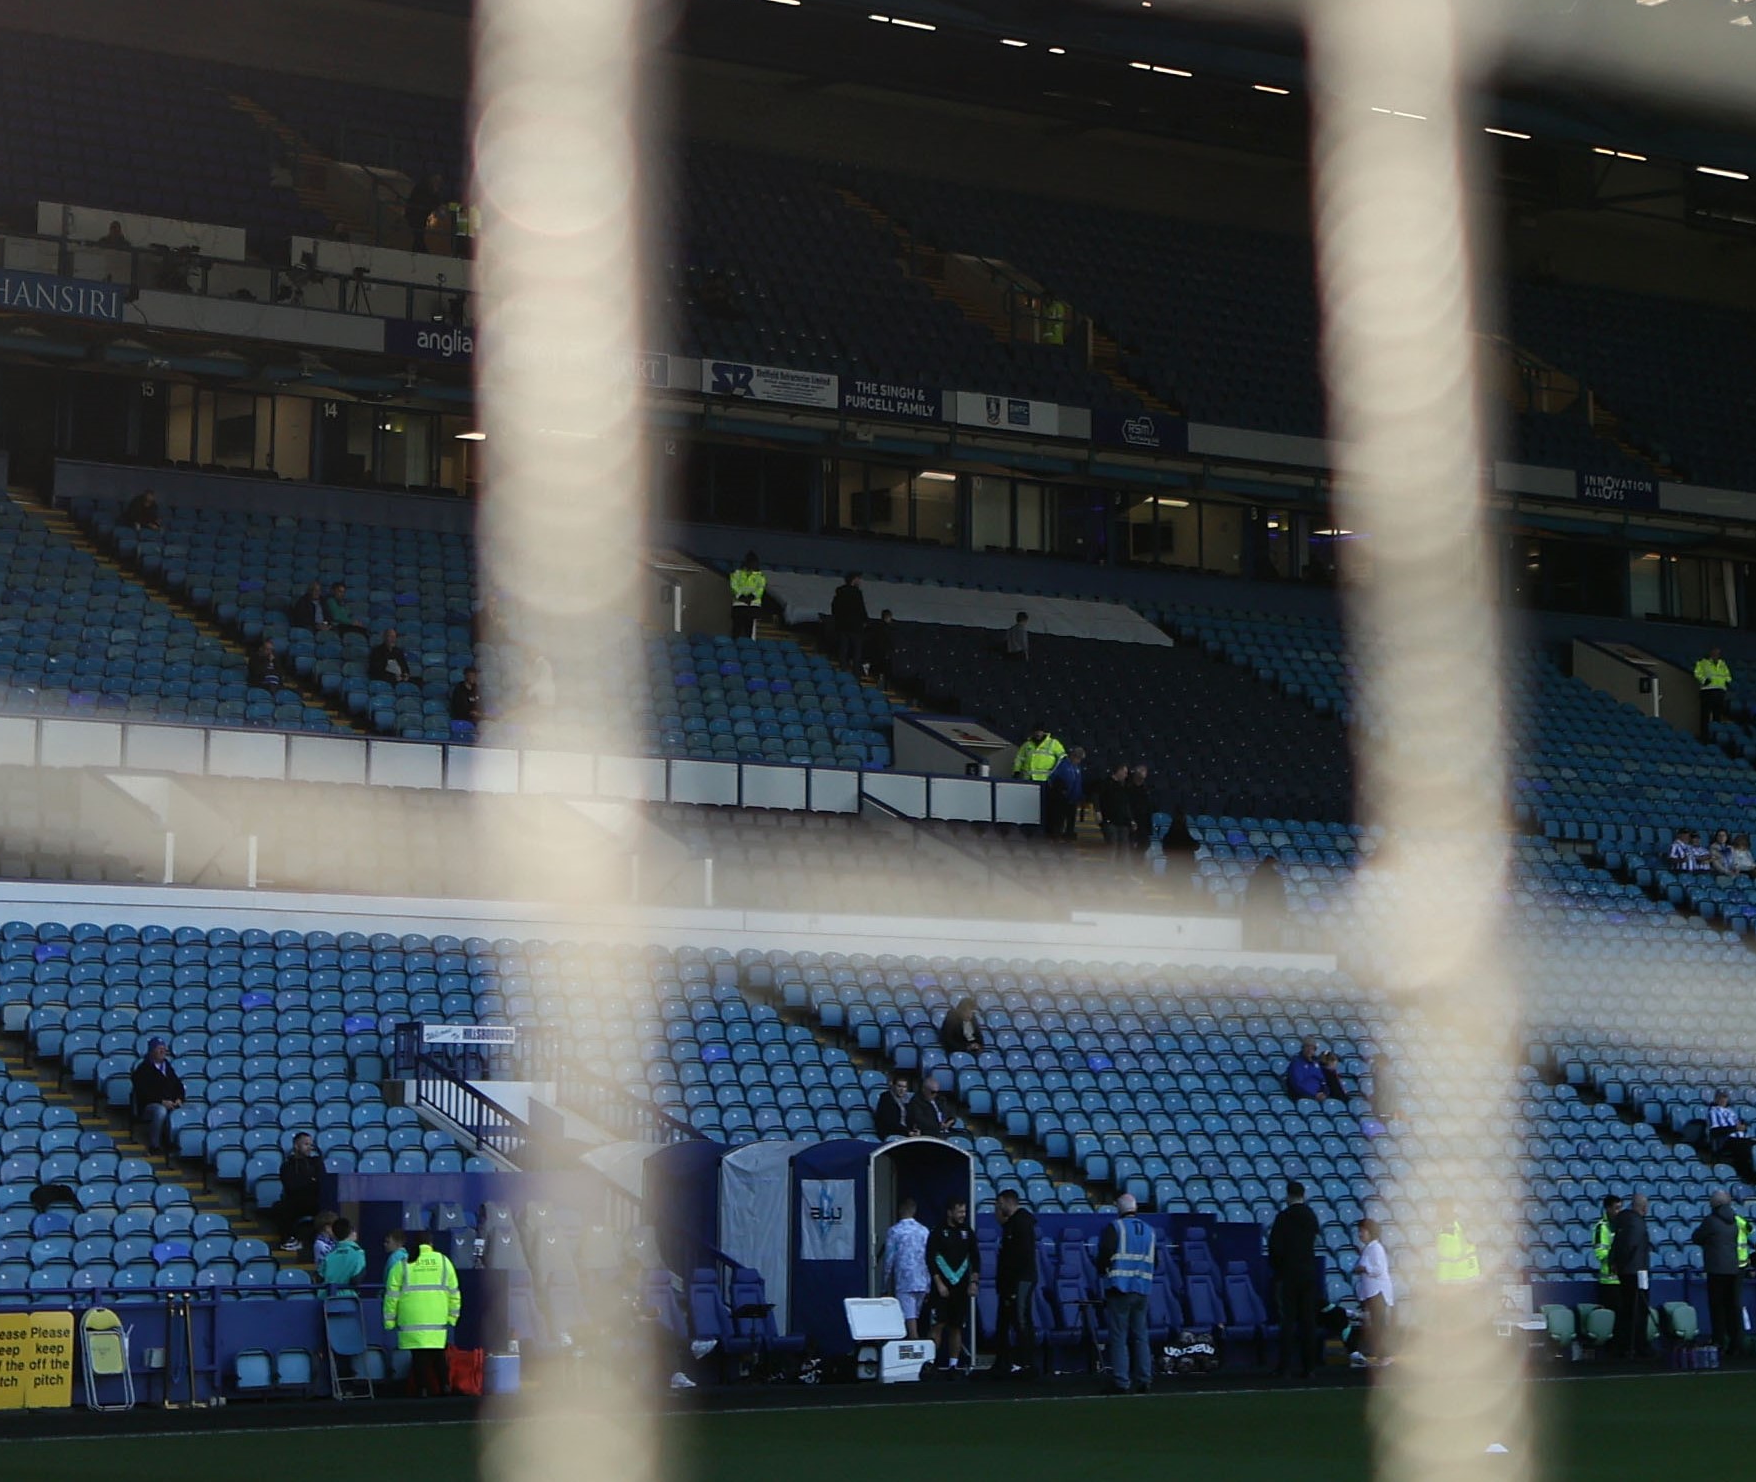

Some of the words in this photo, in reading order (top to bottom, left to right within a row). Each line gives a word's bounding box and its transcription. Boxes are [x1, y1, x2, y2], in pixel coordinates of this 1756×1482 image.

[417, 329, 473, 358] anglia
[140, 382, 155, 397] 15
[855, 381, 879, 395] THE
[880, 384, 916, 401] SINGH
[916, 389, 926, 402] &
[323, 402, 338, 418] 14
[845, 394, 895, 413] PURCELL
[897, 401, 936, 417] FAMILY
[1584, 474, 1652, 493] INNOVATION
[30, 1327, 70, 1339] Please
[35, 1343, 64, 1356] keep
[6, 1359, 25, 1371] the
[29, 1358, 46, 1370] off
[51, 1358, 70, 1370] the
[33, 1374, 64, 1388] pitch
